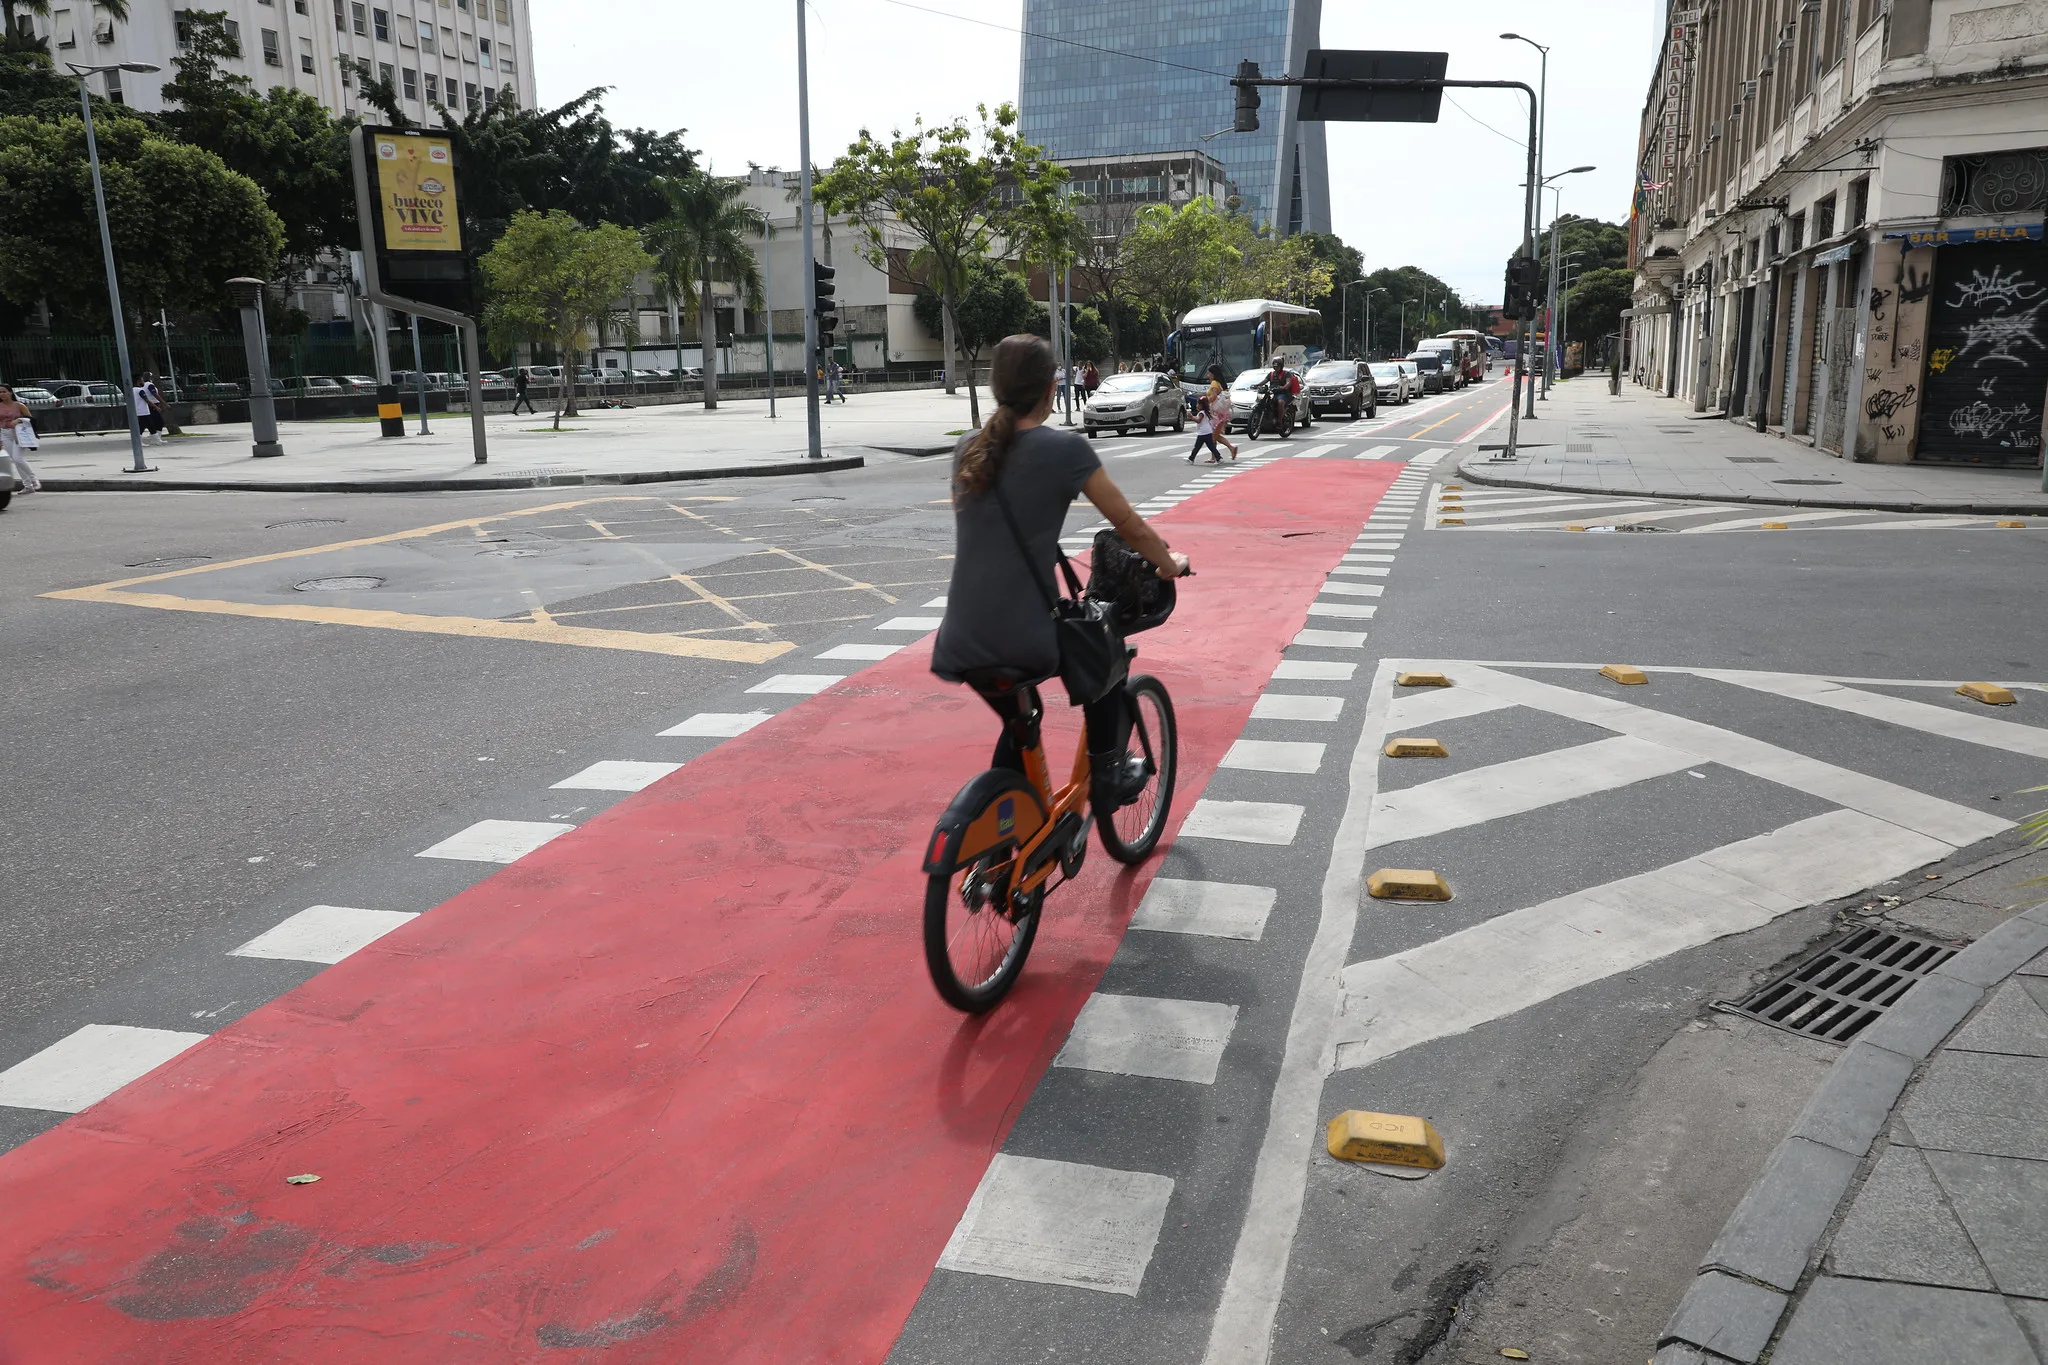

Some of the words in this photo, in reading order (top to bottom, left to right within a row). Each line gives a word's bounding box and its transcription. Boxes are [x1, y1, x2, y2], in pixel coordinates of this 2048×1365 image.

[1673, 12, 1699, 24] HOTEL
[393, 193, 443, 208] buteco
[1909, 231, 1949, 243] BAR
[1973, 227, 2029, 239] BELA
